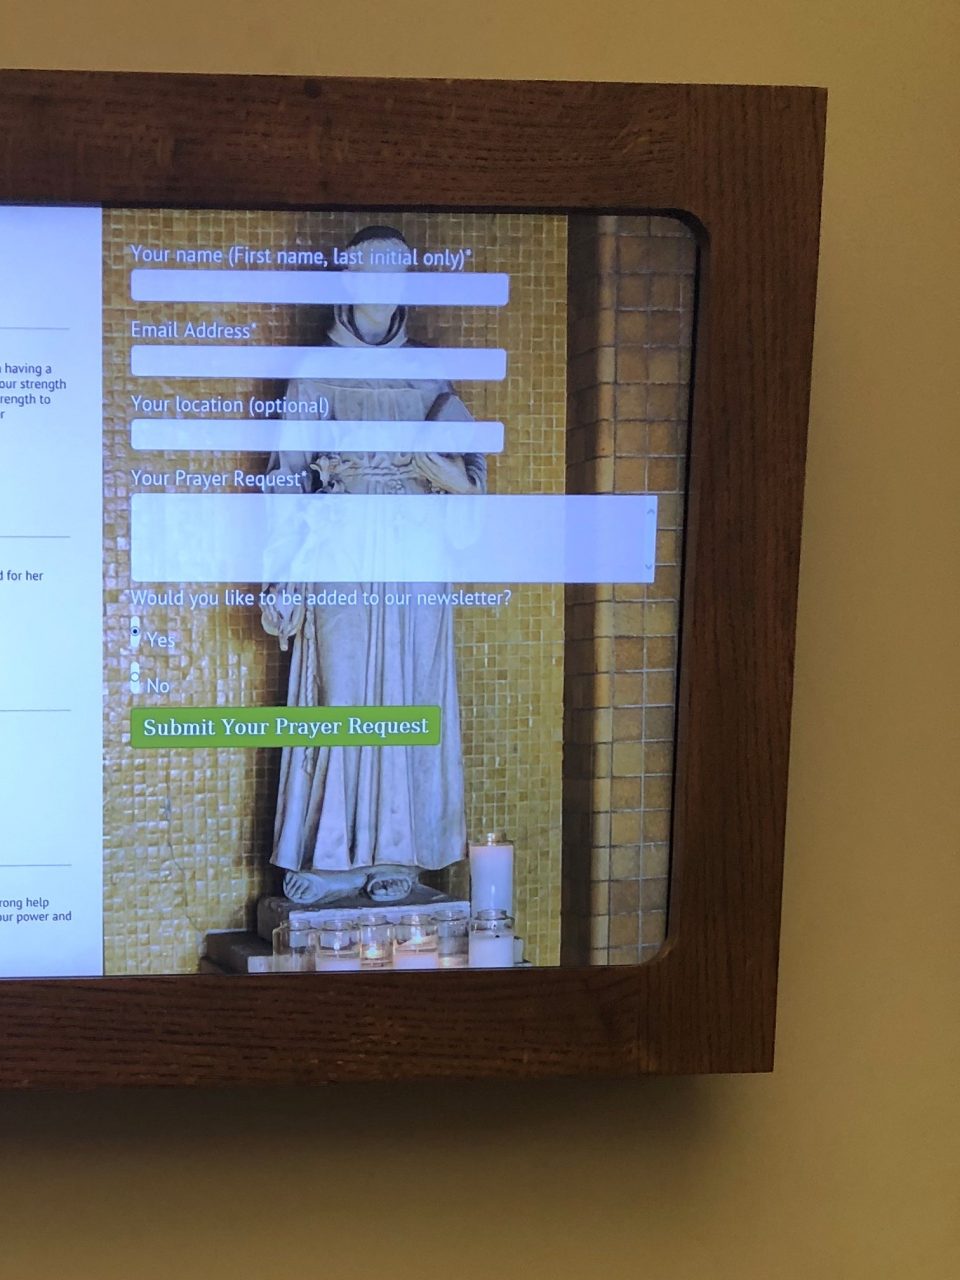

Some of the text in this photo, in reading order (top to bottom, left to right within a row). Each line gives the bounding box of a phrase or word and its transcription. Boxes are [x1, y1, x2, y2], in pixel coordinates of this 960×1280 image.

[130, 246, 170, 263] Your
[176, 250, 222, 263] name
[229, 246, 271, 267] (First
[277, 251, 328, 268] name,
[333, 248, 364, 265] last
[370, 249, 417, 265] initial
[132, 322, 178, 338] Email
[4, 362, 42, 377] having
[44, 365, 52, 374] a
[131, 396, 329, 417] Your location (optional)
[130, 471, 170, 486] Your
[176, 471, 227, 490] Prayer
[131, 590, 512, 609] Would you like to be added to our newsletter?
[146, 633, 176, 648] Yes
[147, 679, 170, 694] No
[144, 718, 429, 739] Submit Your Prayer Request
[25, 897, 49, 909] help
